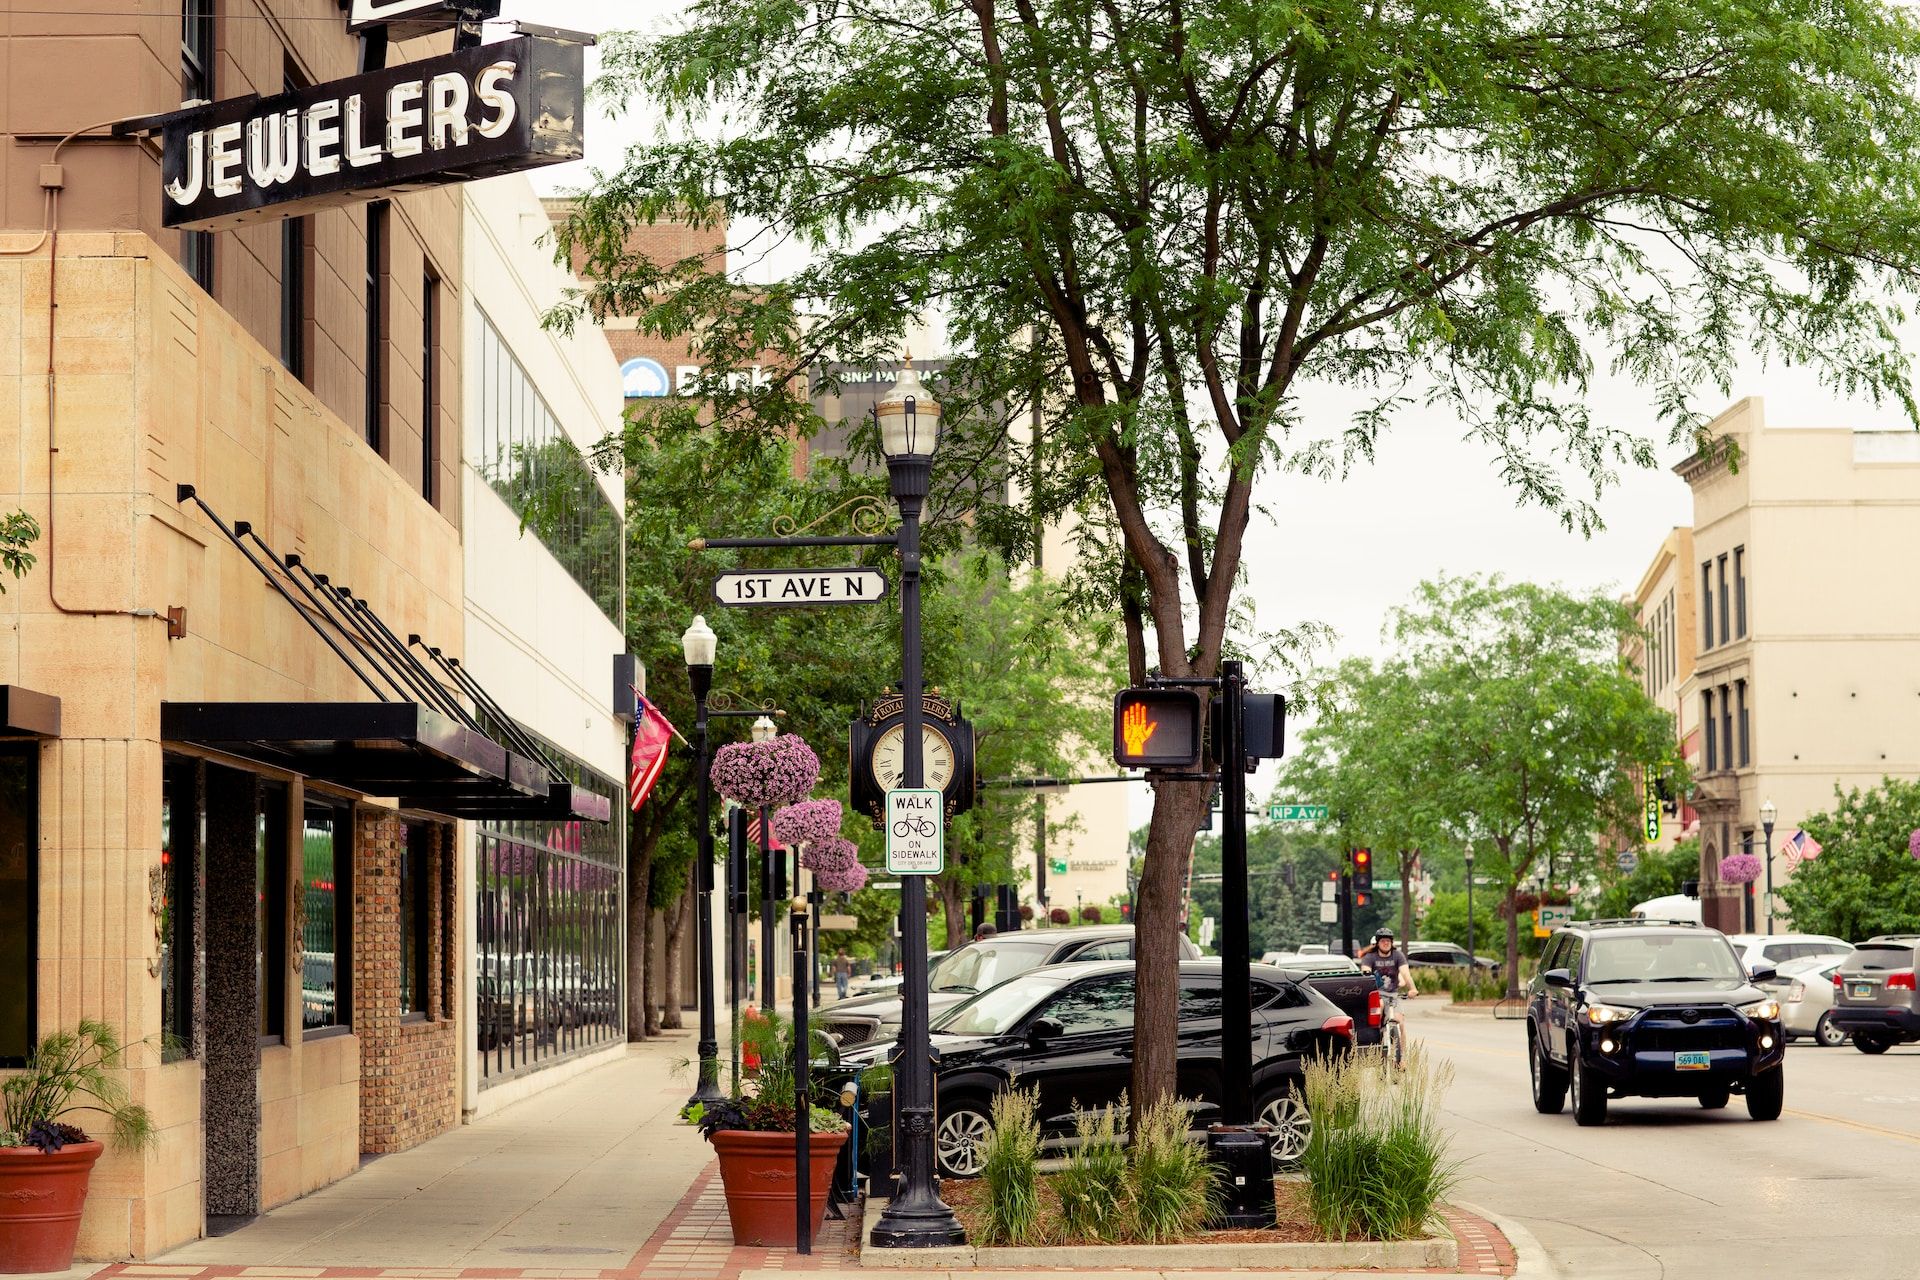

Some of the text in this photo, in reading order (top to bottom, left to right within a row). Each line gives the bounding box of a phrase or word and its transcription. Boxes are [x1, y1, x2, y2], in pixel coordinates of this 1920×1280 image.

[164, 60, 516, 206] JEWELERS
[734, 577, 863, 599] 1ST AVE N
[896, 797, 933, 809] WALK
[1273, 807, 1293, 819] NP
[908, 840, 921, 849] ON
[892, 850, 937, 859] SIDEWALK
[1542, 911, 1554, 926] P
